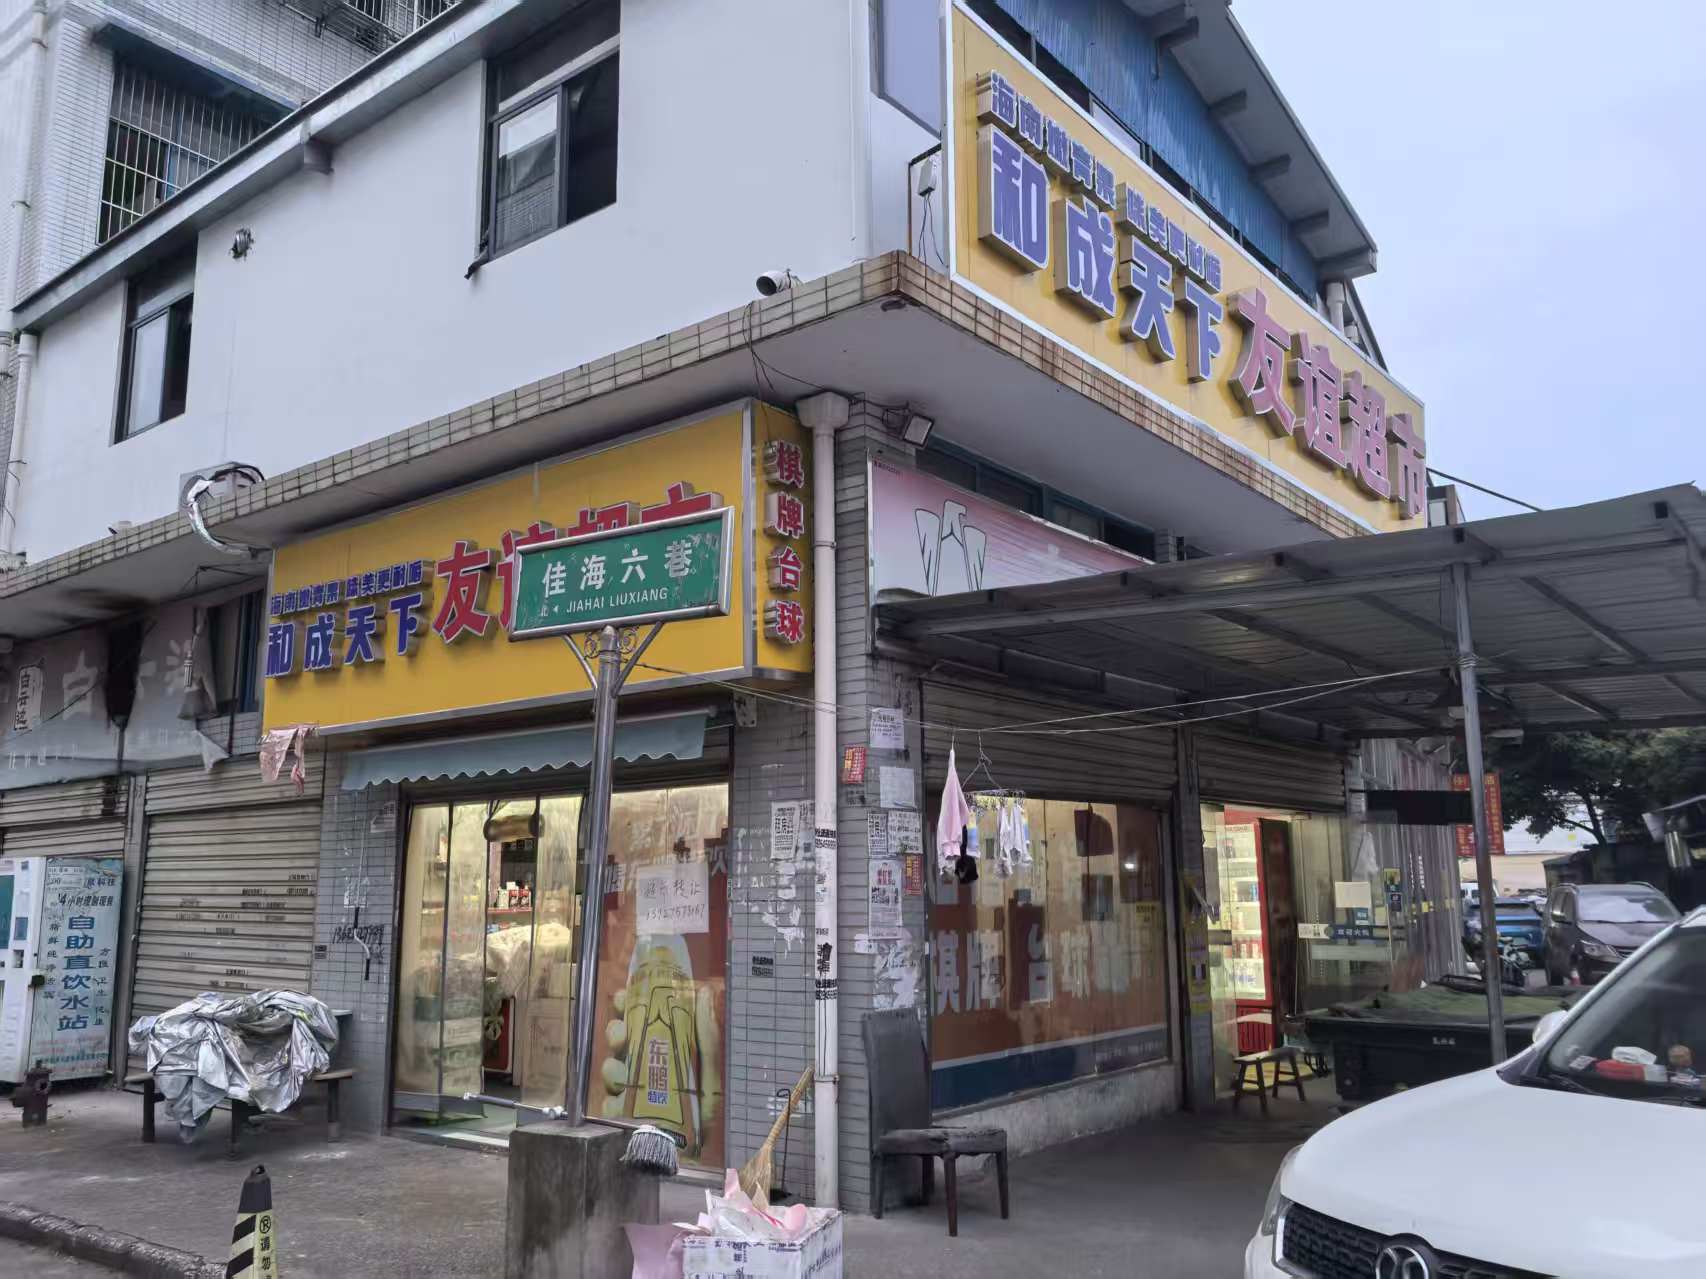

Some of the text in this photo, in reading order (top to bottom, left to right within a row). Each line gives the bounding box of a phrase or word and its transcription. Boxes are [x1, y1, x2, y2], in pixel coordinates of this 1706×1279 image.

[991, 125, 1427, 519] 和成天下 友谊超市
[541, 539, 692, 599] 佳海六巷
[776, 440, 804, 644] 棋牌台球
[265, 592, 422, 678] 和成天下
[566, 587, 668, 613] JIAHAI LIUXIANG
[56, 914, 95, 1031] 自助直饮水站
[260, 1235, 272, 1279] 请勿
